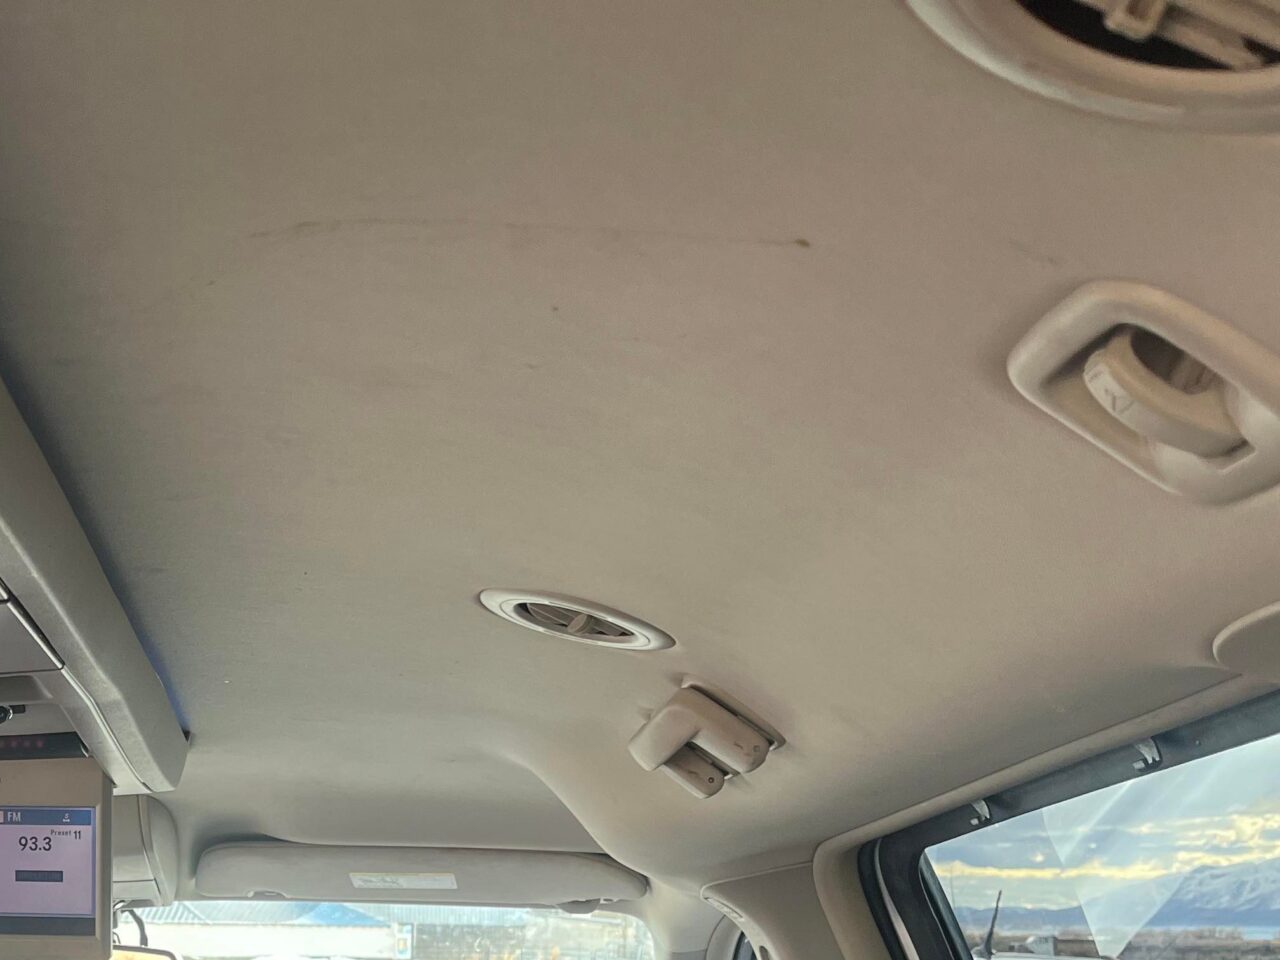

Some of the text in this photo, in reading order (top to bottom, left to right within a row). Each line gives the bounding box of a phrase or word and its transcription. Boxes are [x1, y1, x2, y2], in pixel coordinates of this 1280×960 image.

[7, 811, 22, 822] FM
[73, 830, 82, 840] 11
[18, 836, 53, 851] 93.3
